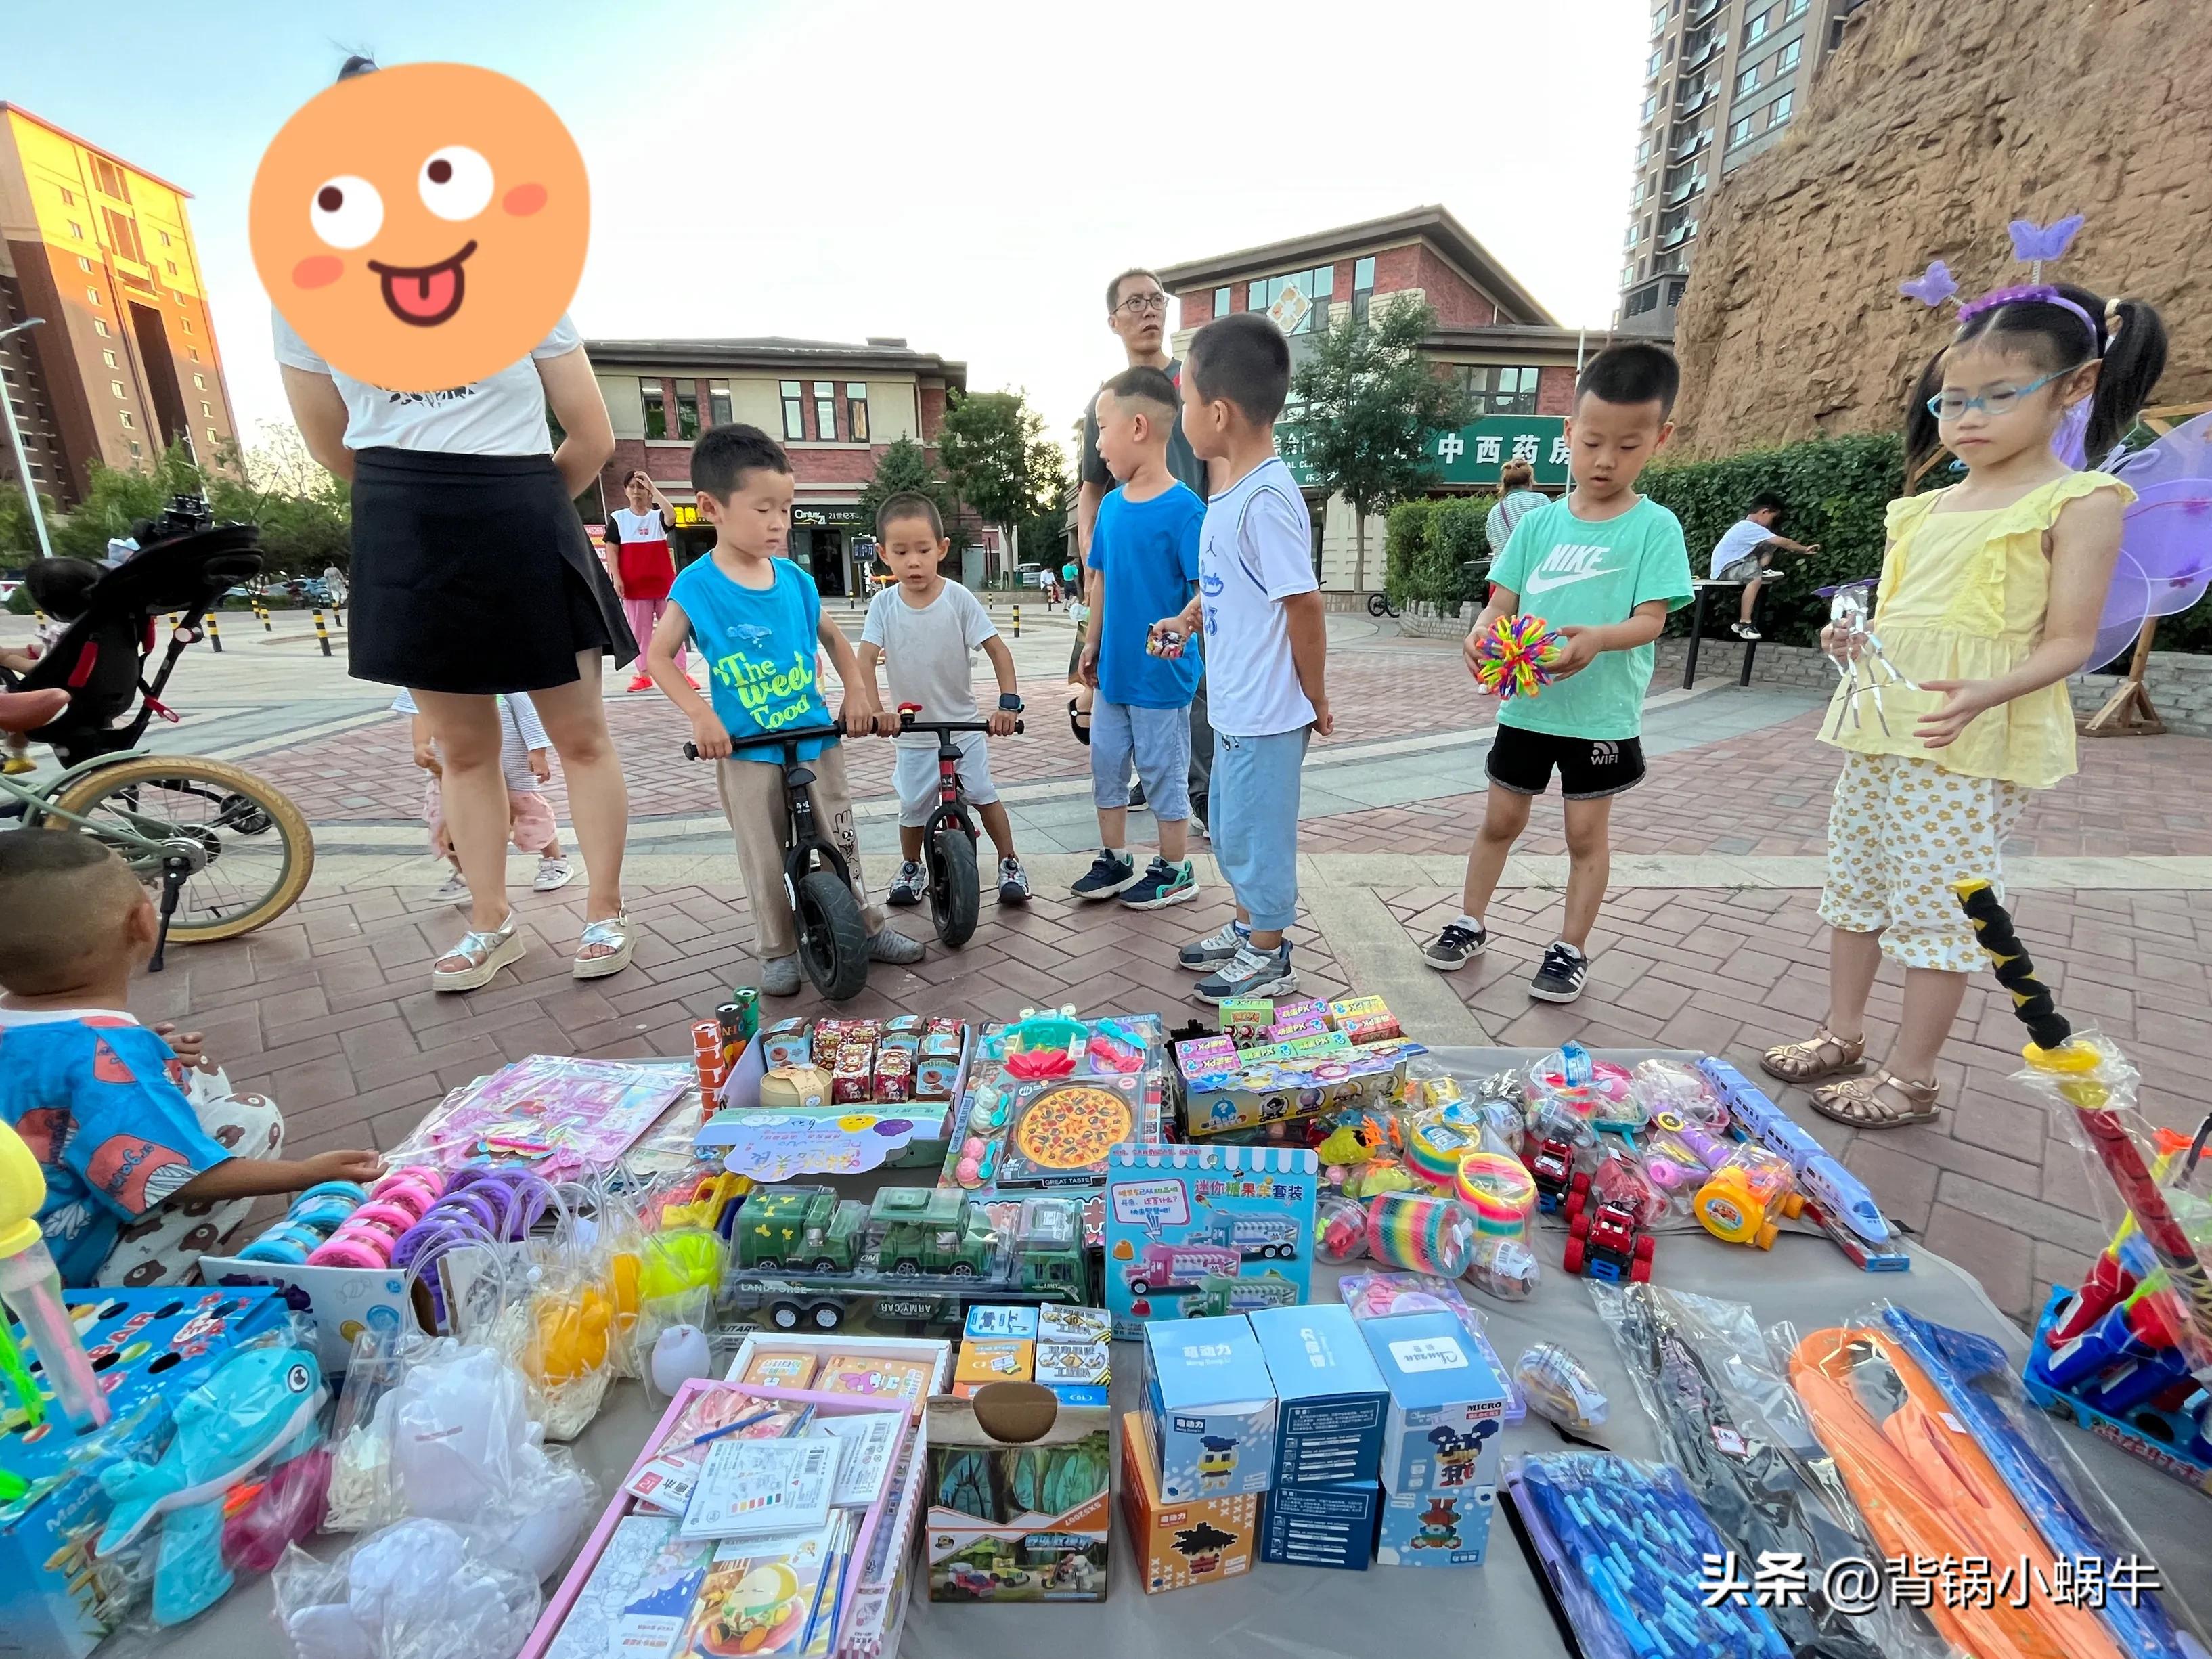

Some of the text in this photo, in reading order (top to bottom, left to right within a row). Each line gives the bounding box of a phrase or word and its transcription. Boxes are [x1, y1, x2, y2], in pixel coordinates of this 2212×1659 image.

[1438, 433, 1570, 464] 中西药房
[1542, 544, 1611, 573] NIKE
[1591, 755, 1618, 765] WIFI
[1195, 1180, 1302, 1201] 迷你糖果车套装
[881, 1304, 931, 1312] ARMY CAR
[1467, 1402, 1502, 1411] MICRO
[1467, 1411, 1500, 1419] BLOCKS
